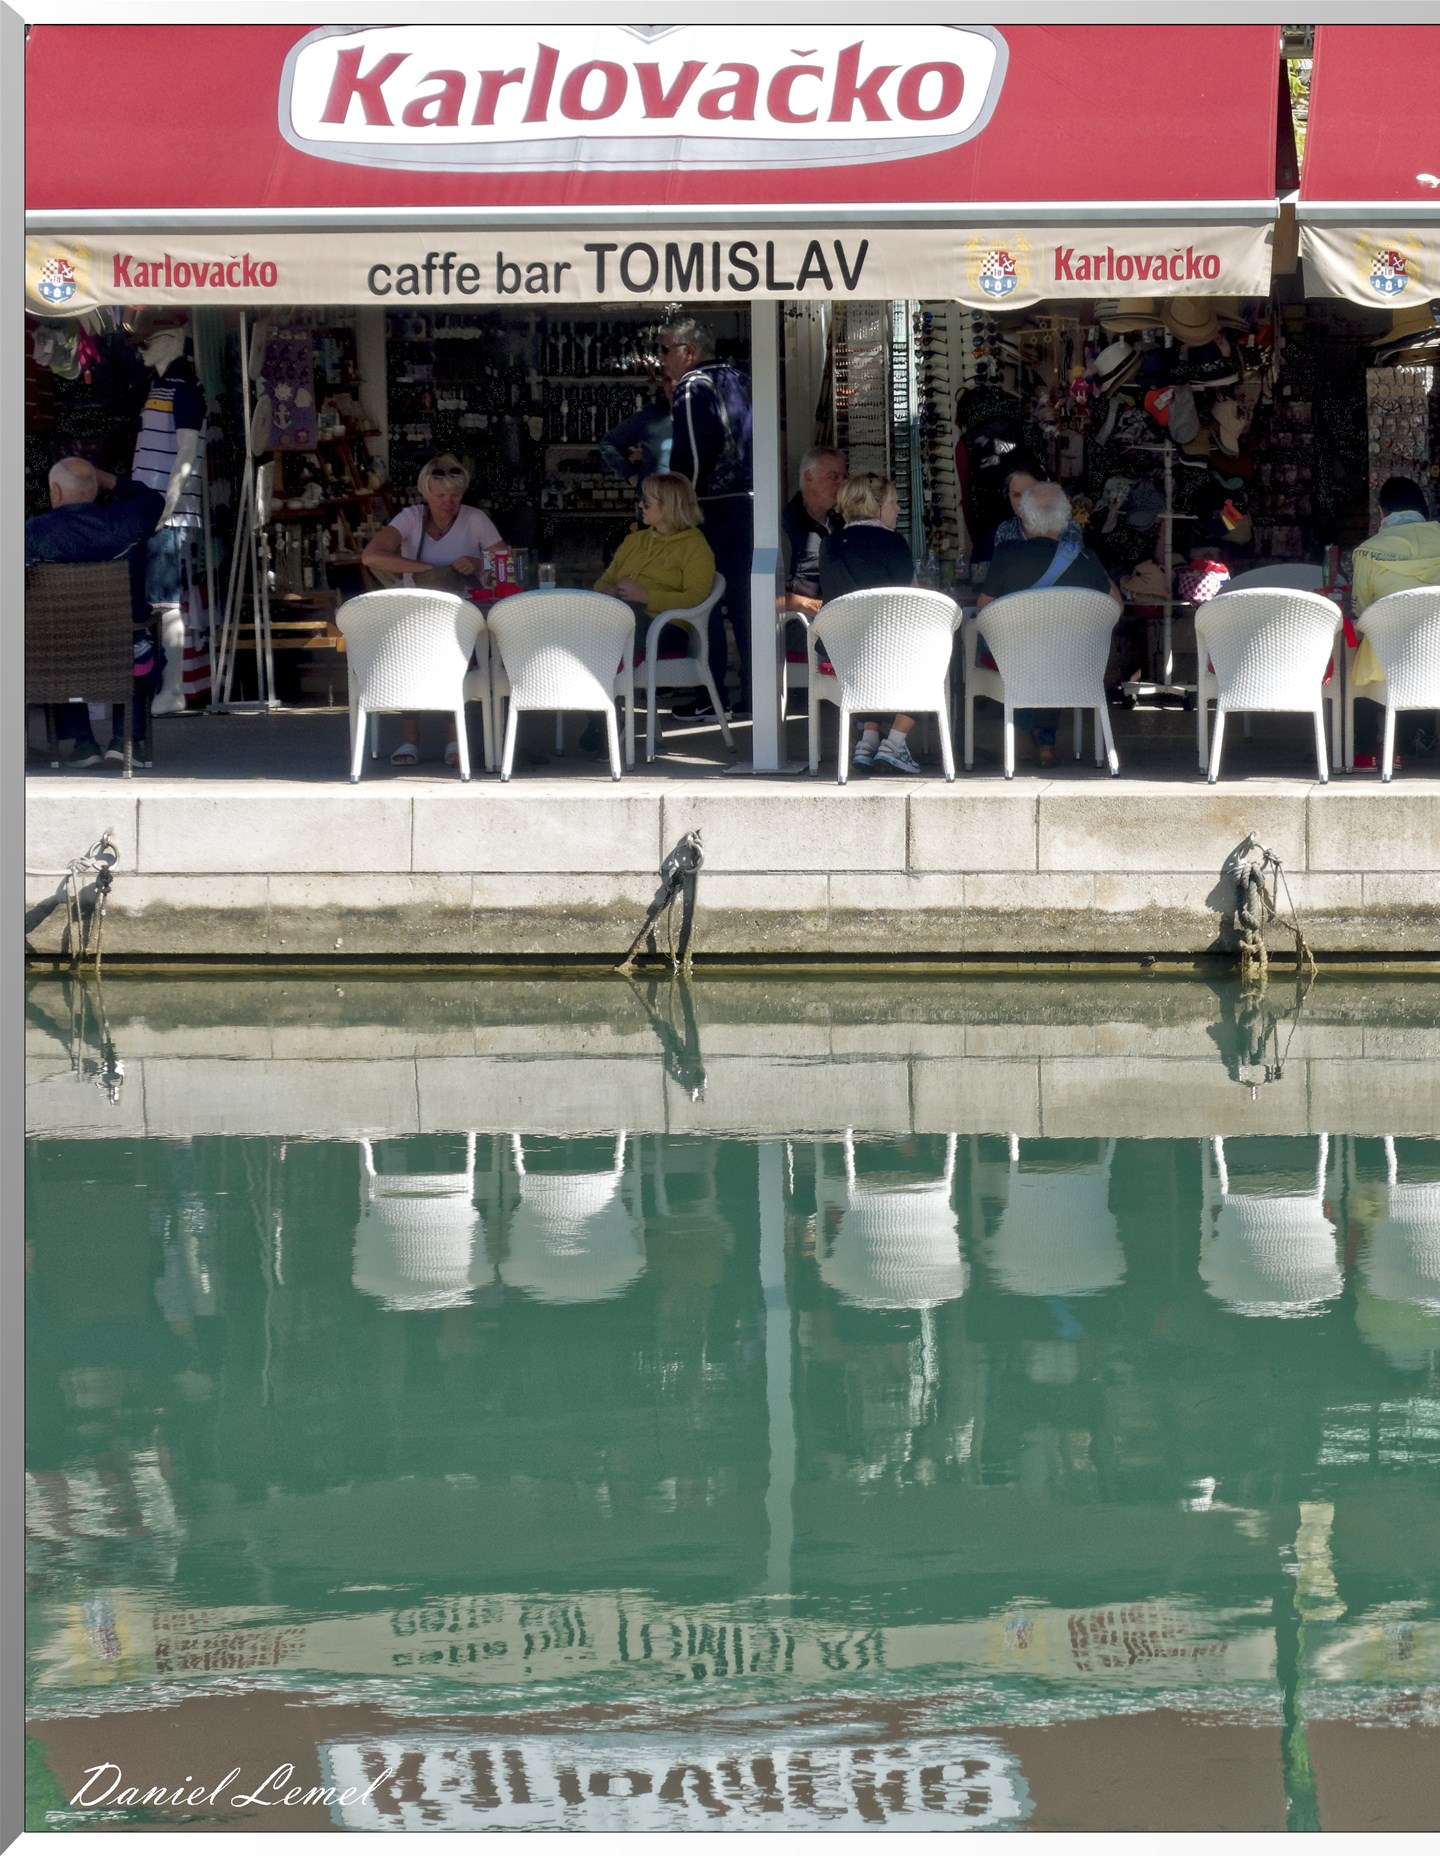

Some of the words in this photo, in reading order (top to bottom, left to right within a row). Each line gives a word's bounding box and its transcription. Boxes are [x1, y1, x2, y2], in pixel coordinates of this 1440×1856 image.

[320, 40, 966, 127] Karlovačko
[113, 252, 278, 288] Karlovačko
[367, 251, 481, 296] caffe
[496, 251, 571, 295] bar
[583, 239, 869, 294] TOMISLAV
[1054, 245, 1220, 281] Karlovačko
